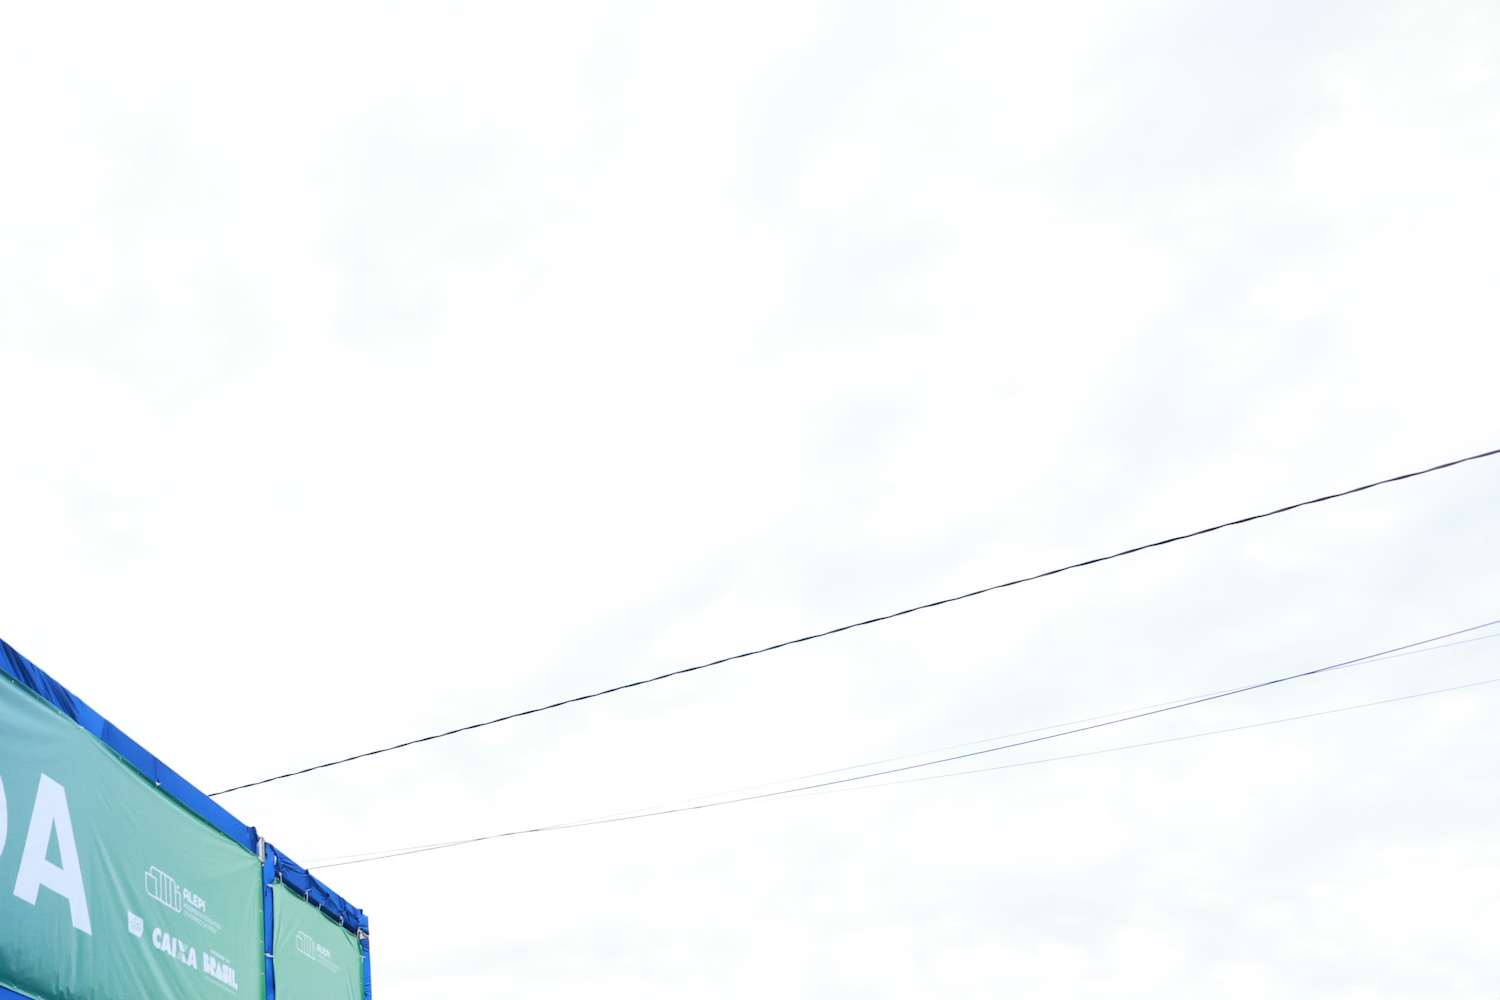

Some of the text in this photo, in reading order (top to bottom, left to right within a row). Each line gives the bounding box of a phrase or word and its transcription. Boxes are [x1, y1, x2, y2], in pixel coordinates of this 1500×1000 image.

[182, 888, 206, 912] ALEPI
[152, 928, 198, 970] CAIXA
[203, 952, 238, 990] BRASIL
